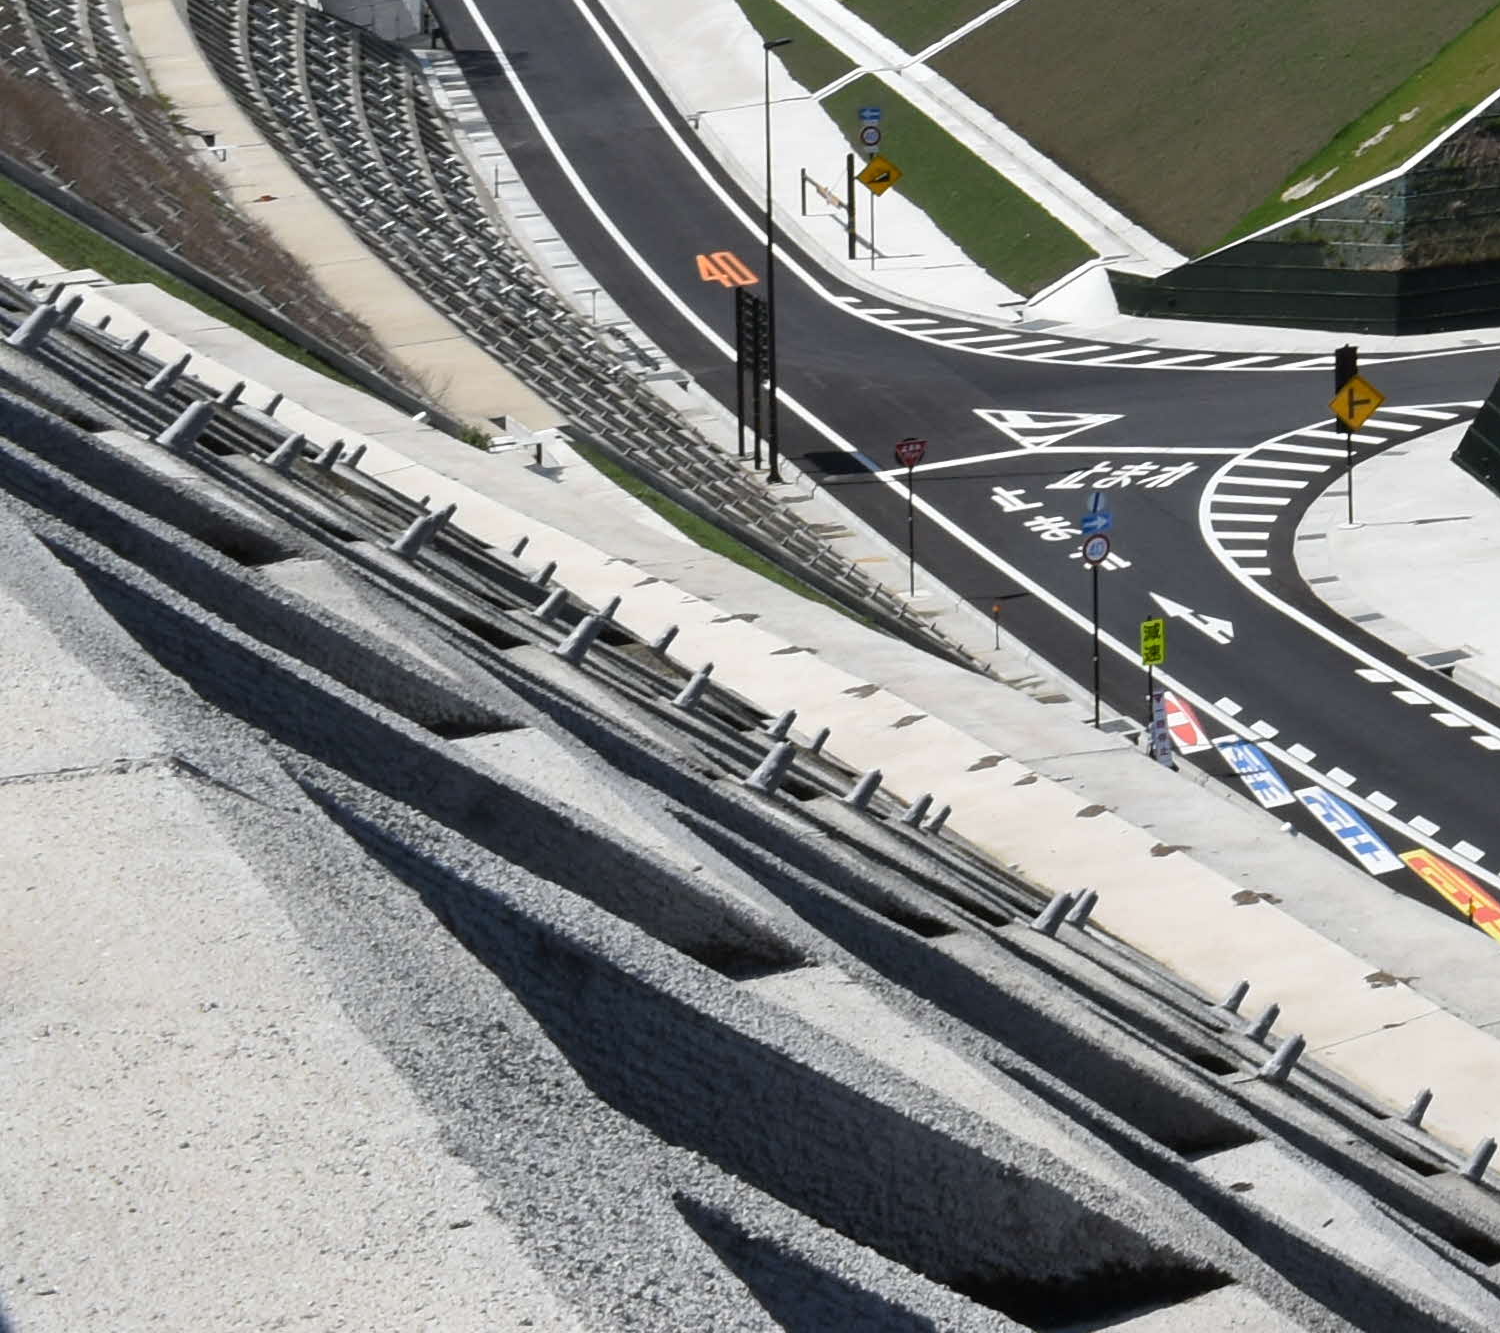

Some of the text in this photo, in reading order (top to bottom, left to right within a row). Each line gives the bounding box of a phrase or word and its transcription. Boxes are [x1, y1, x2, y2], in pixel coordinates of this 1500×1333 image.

[696, 251, 759, 288] 40
[1045, 461, 1200, 490] 止まれ
[1143, 622, 1162, 663] 減速
